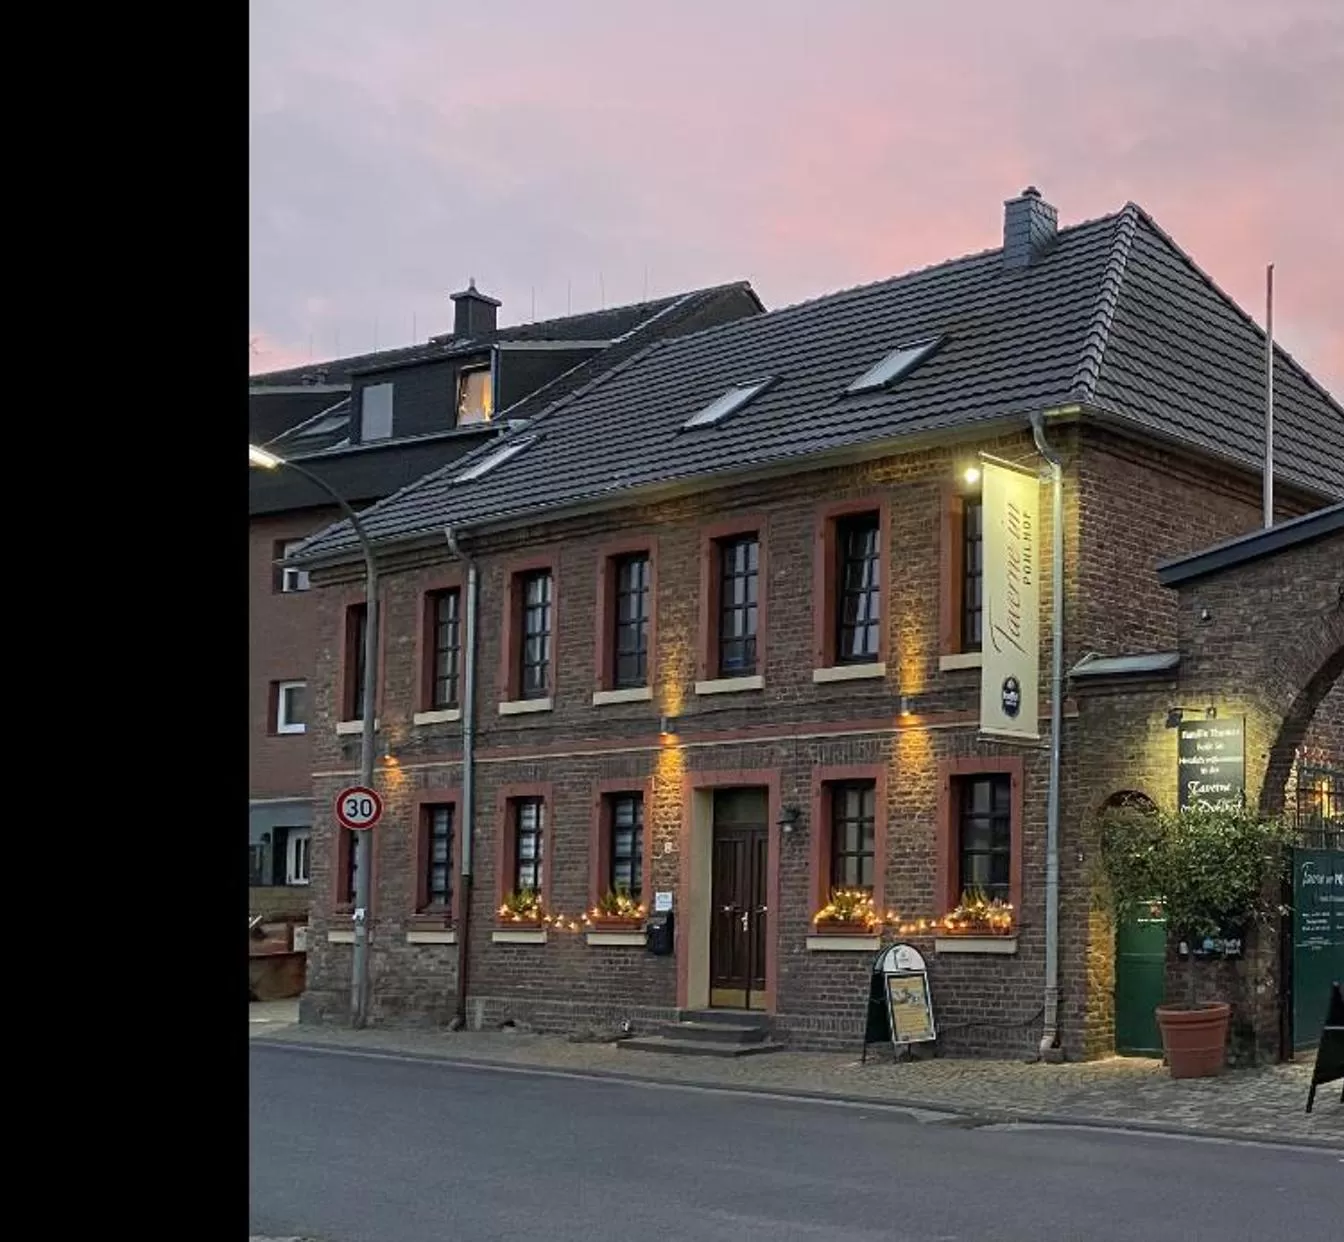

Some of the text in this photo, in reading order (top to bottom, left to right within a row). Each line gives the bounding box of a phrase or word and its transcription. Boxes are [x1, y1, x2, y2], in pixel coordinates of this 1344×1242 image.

[1022, 511, 1032, 586] POHLHOF
[989, 501, 1030, 654] Taverne im
[346, 798, 372, 817] 30
[1187, 780, 1232, 796] Taverne
